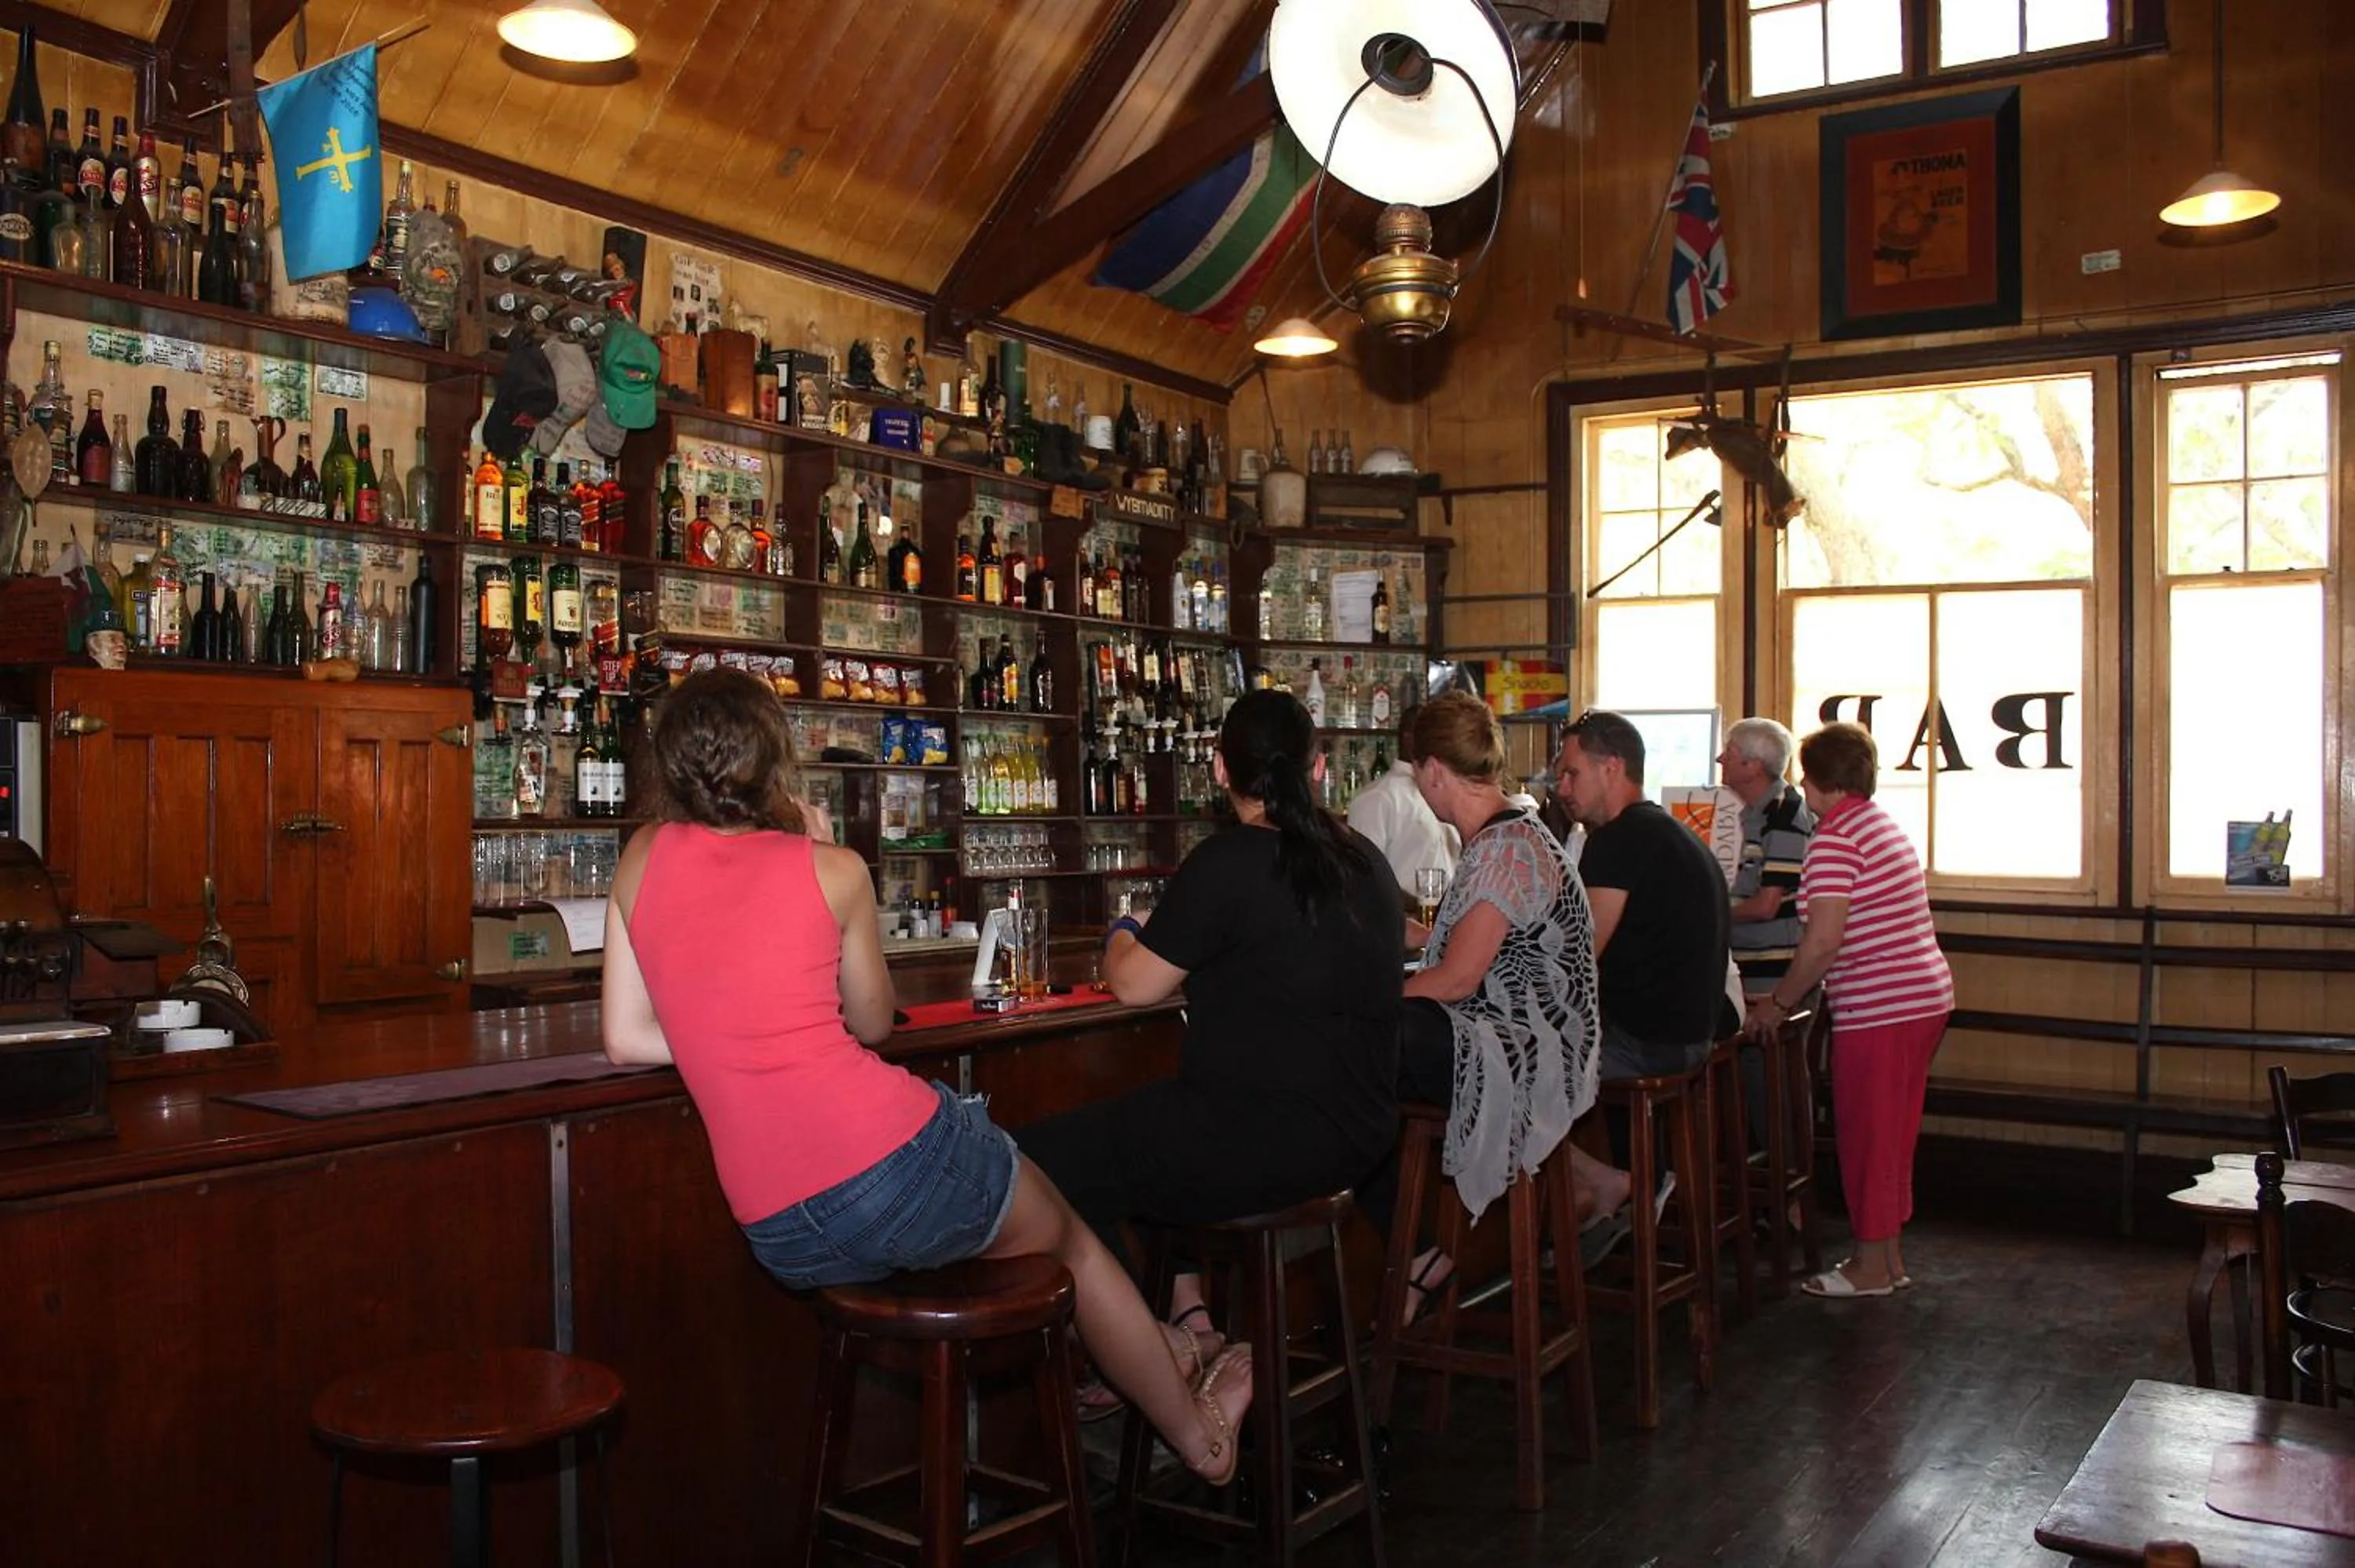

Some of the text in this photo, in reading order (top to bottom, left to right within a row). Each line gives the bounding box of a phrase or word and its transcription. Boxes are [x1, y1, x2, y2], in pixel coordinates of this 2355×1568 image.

[602, 660, 622, 672] STEP
[605, 672, 616, 682] UP
[1716, 802, 1736, 884] NDABA
